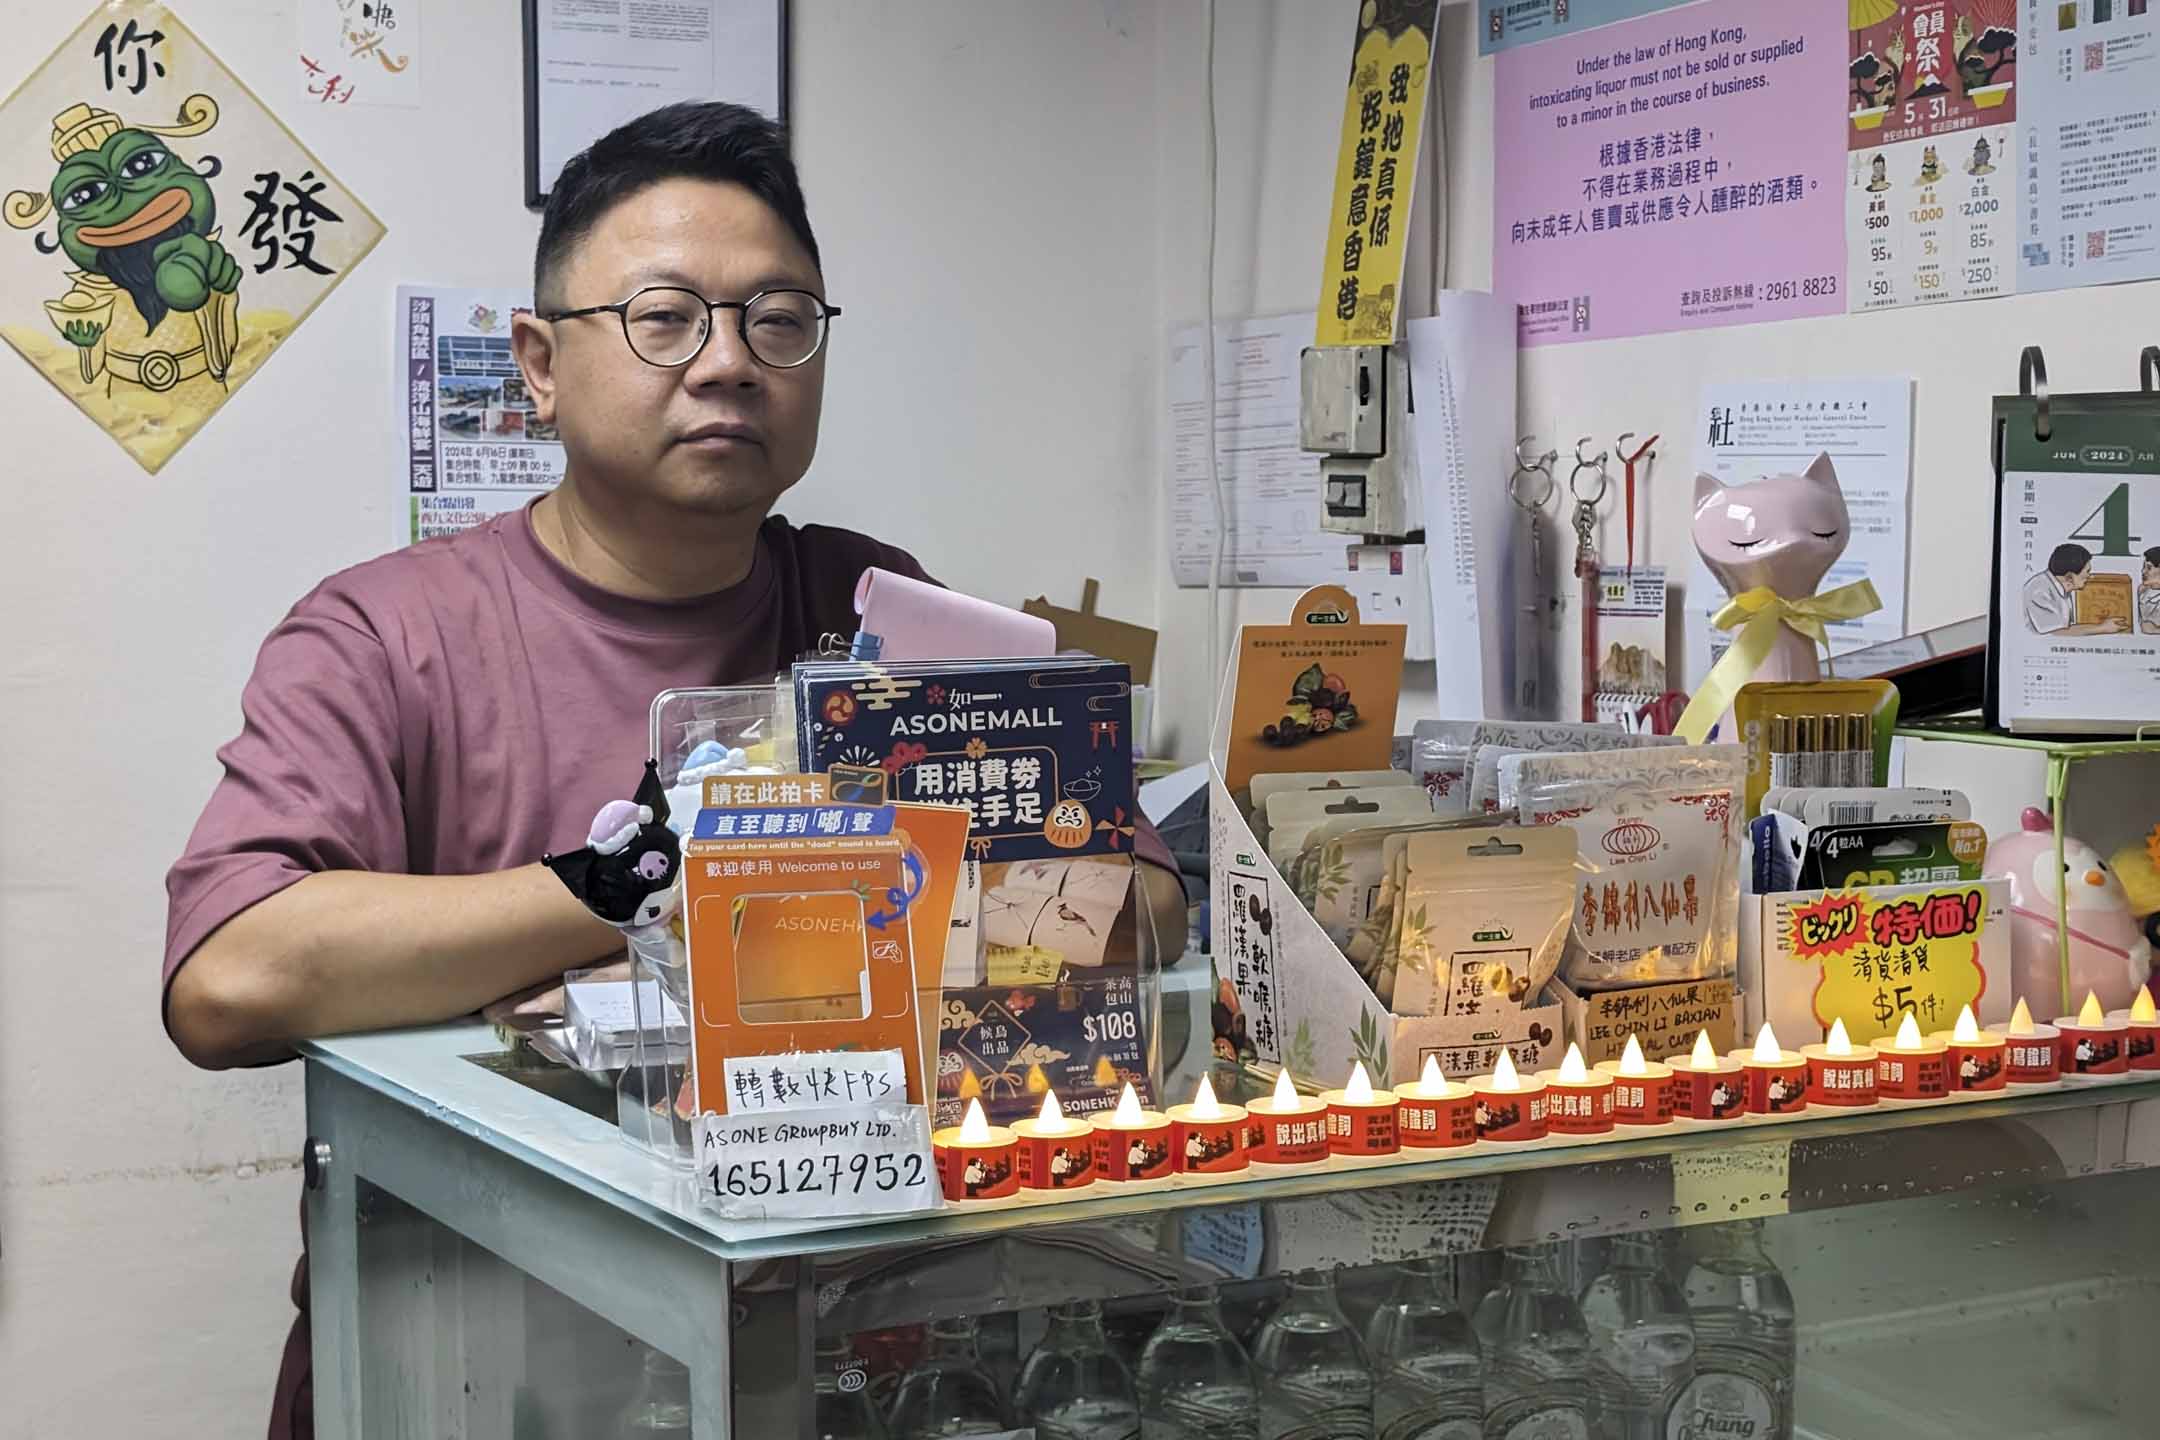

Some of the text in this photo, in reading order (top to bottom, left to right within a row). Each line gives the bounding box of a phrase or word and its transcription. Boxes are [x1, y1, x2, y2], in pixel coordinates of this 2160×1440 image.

[1914, 10, 1946, 38] 會員
[95, 19, 165, 94] 你
[1576, 26, 1747, 75] Under the law of Hong Kong,
[1916, 38, 1940, 73] 祭
[1529, 36, 1803, 110] intoxicating liquor must not be sold or supplied
[1556, 73, 1770, 128] to a minor in the course of business.
[1599, 127, 1715, 168] 根據香港法律，
[1583, 156, 1733, 202] 不得在業務過程中，
[239, 171, 344, 275] 發
[1865, 215, 1889, 230] $500
[1909, 207, 1944, 224] $1,000
[1960, 199, 1999, 216] $2,000
[1766, 280, 1797, 301] 2961
[1803, 276, 1837, 296] 8823
[2068, 483, 2142, 557] 4
[889, 707, 1063, 737] ASONEMALL
[710, 782, 825, 805] 請在此拍卡
[705, 843, 726, 852] your
[727, 841, 747, 850] card
[748, 841, 768, 850] here
[769, 841, 790, 849] until
[791, 840, 804, 849] the
[838, 839, 864, 848] sound
[865, 839, 874, 847] is
[706, 860, 881, 878] 歡迎使用 Welcome to use
[1801, 902, 1858, 946] ビックリ
[1083, 1012, 1136, 1042] $108
[1590, 1007, 1721, 1041] LEE CHIN LI BAXIAN
[708, 1153, 926, 1197] 165127952
